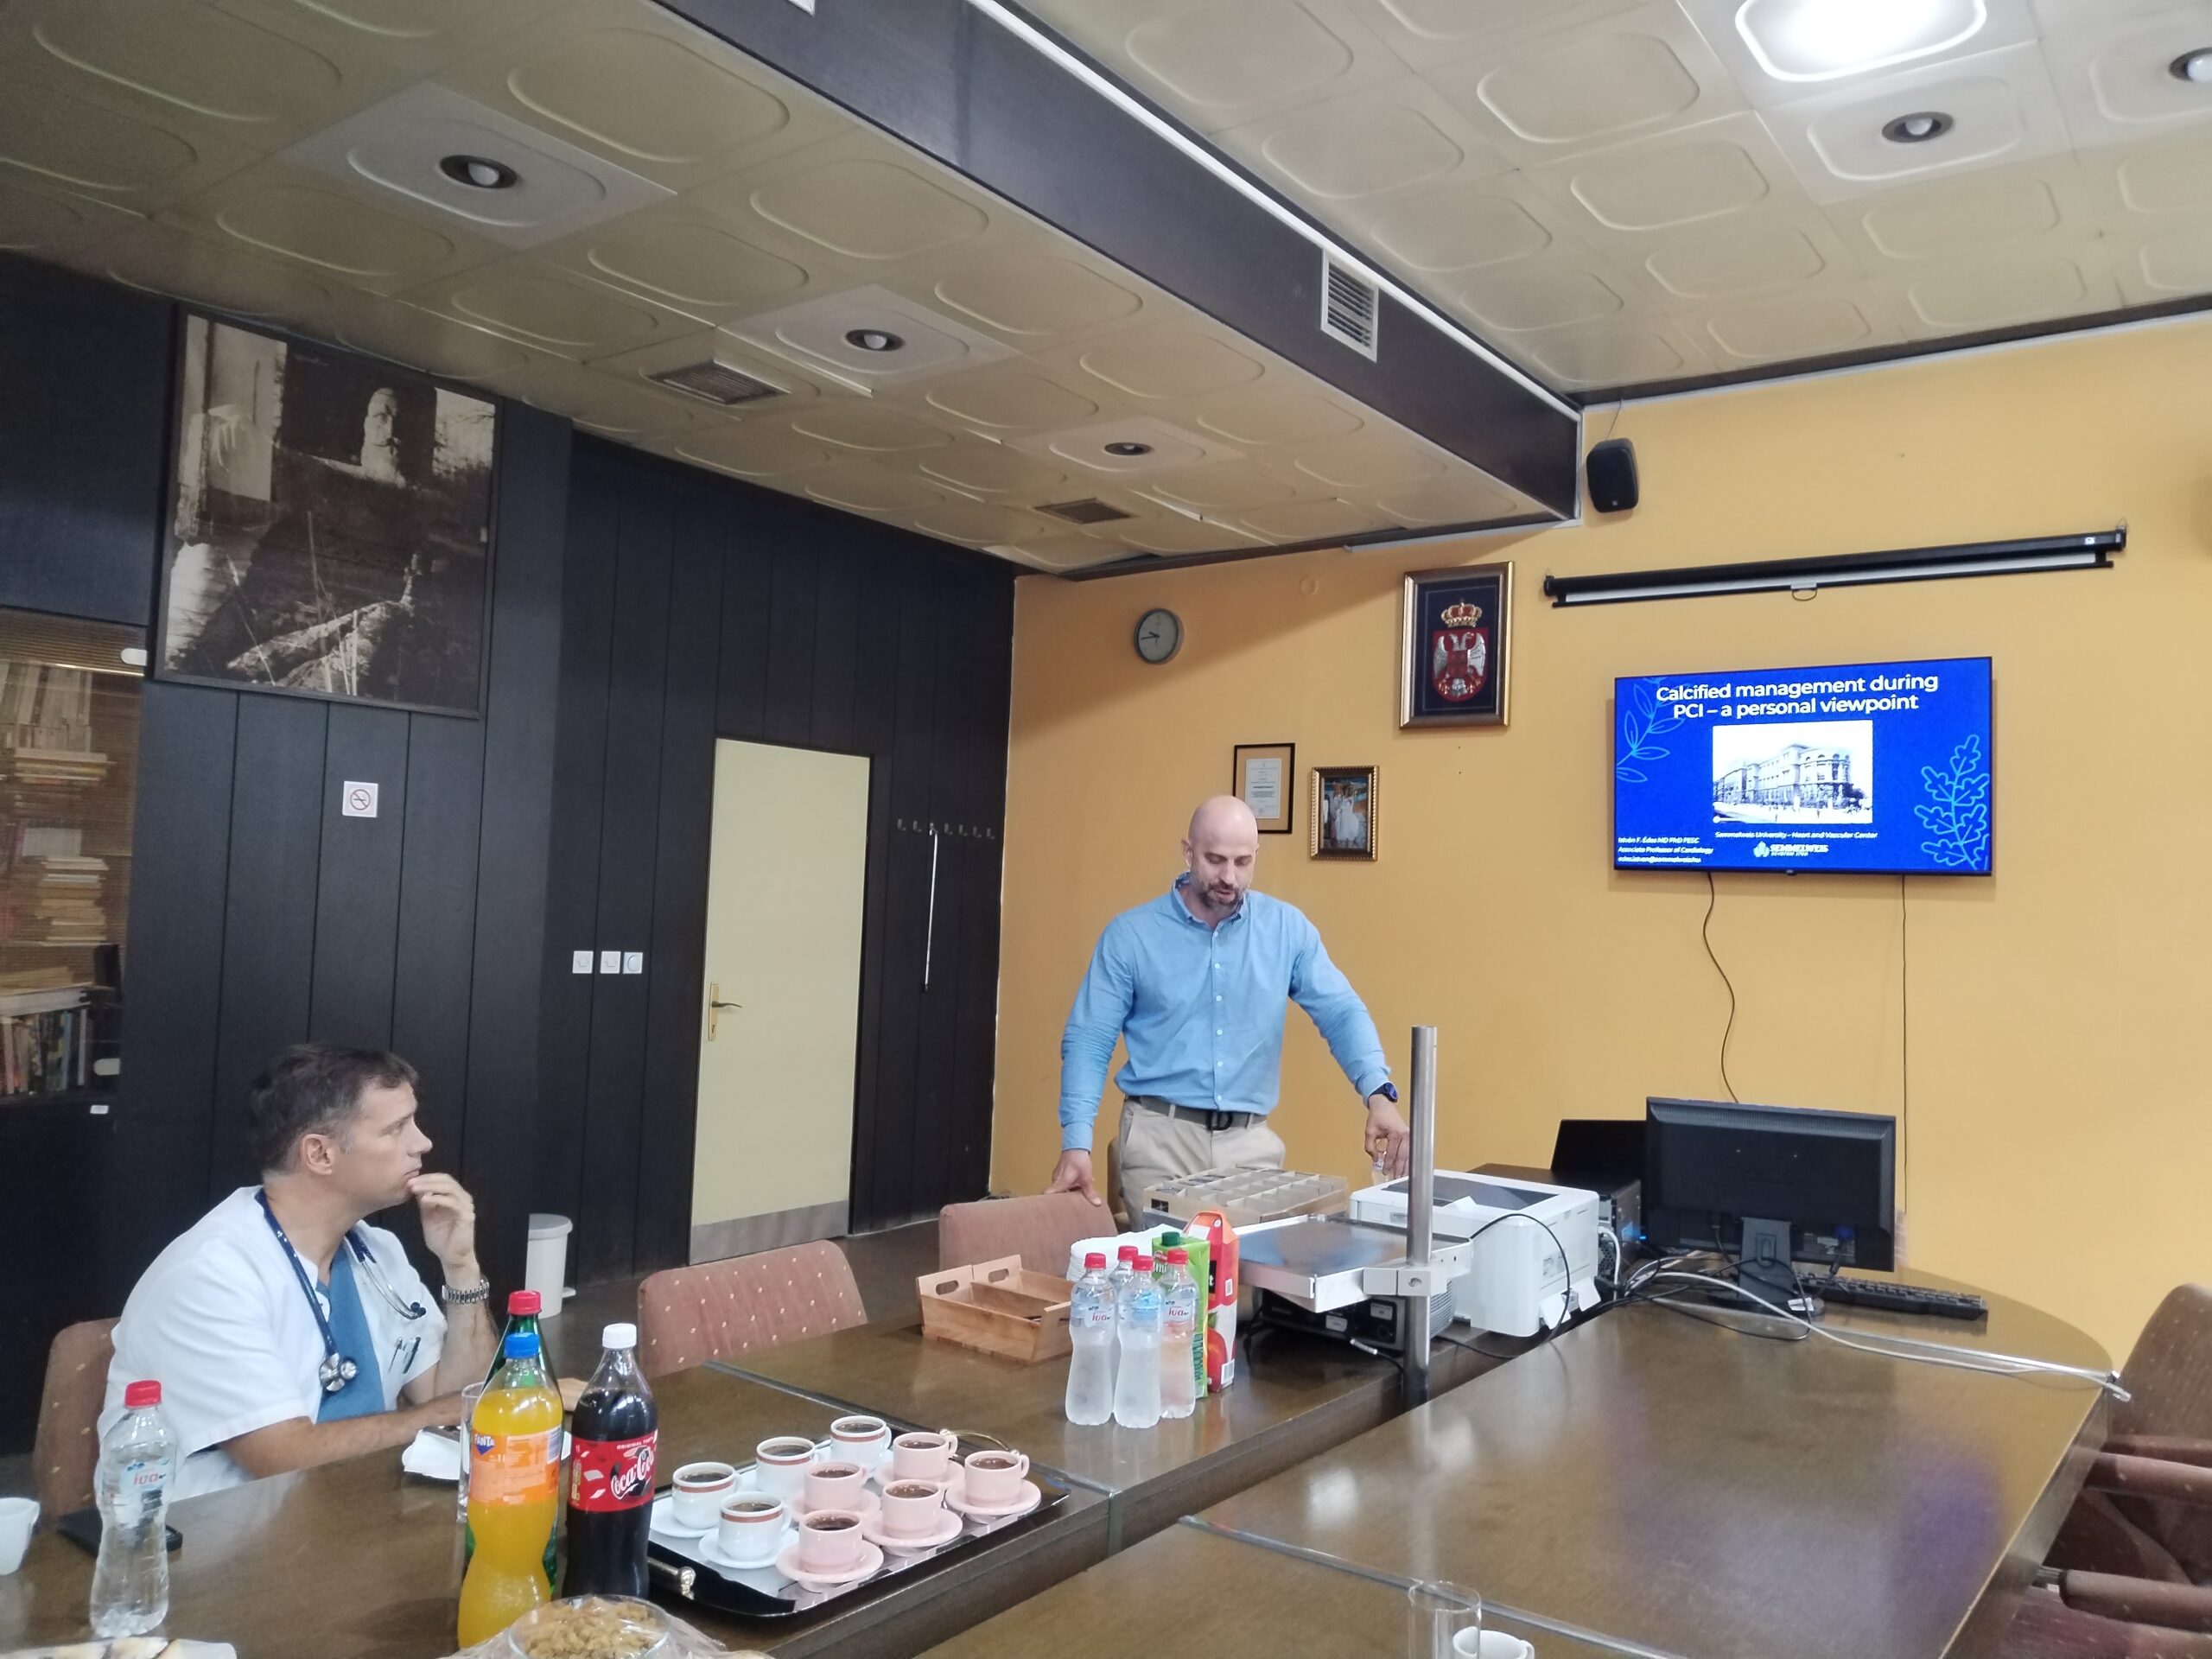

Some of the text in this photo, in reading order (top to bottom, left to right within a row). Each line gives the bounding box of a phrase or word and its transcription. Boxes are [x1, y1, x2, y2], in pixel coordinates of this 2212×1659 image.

[1656, 673, 1939, 702] Calcified management during
[1673, 703, 1703, 719] PCI
[1720, 705, 1733, 717] a
[1737, 697, 1816, 719] personal
[1820, 694, 1920, 713] viewpoint
[610, 1446, 654, 1499] Coca-Col
